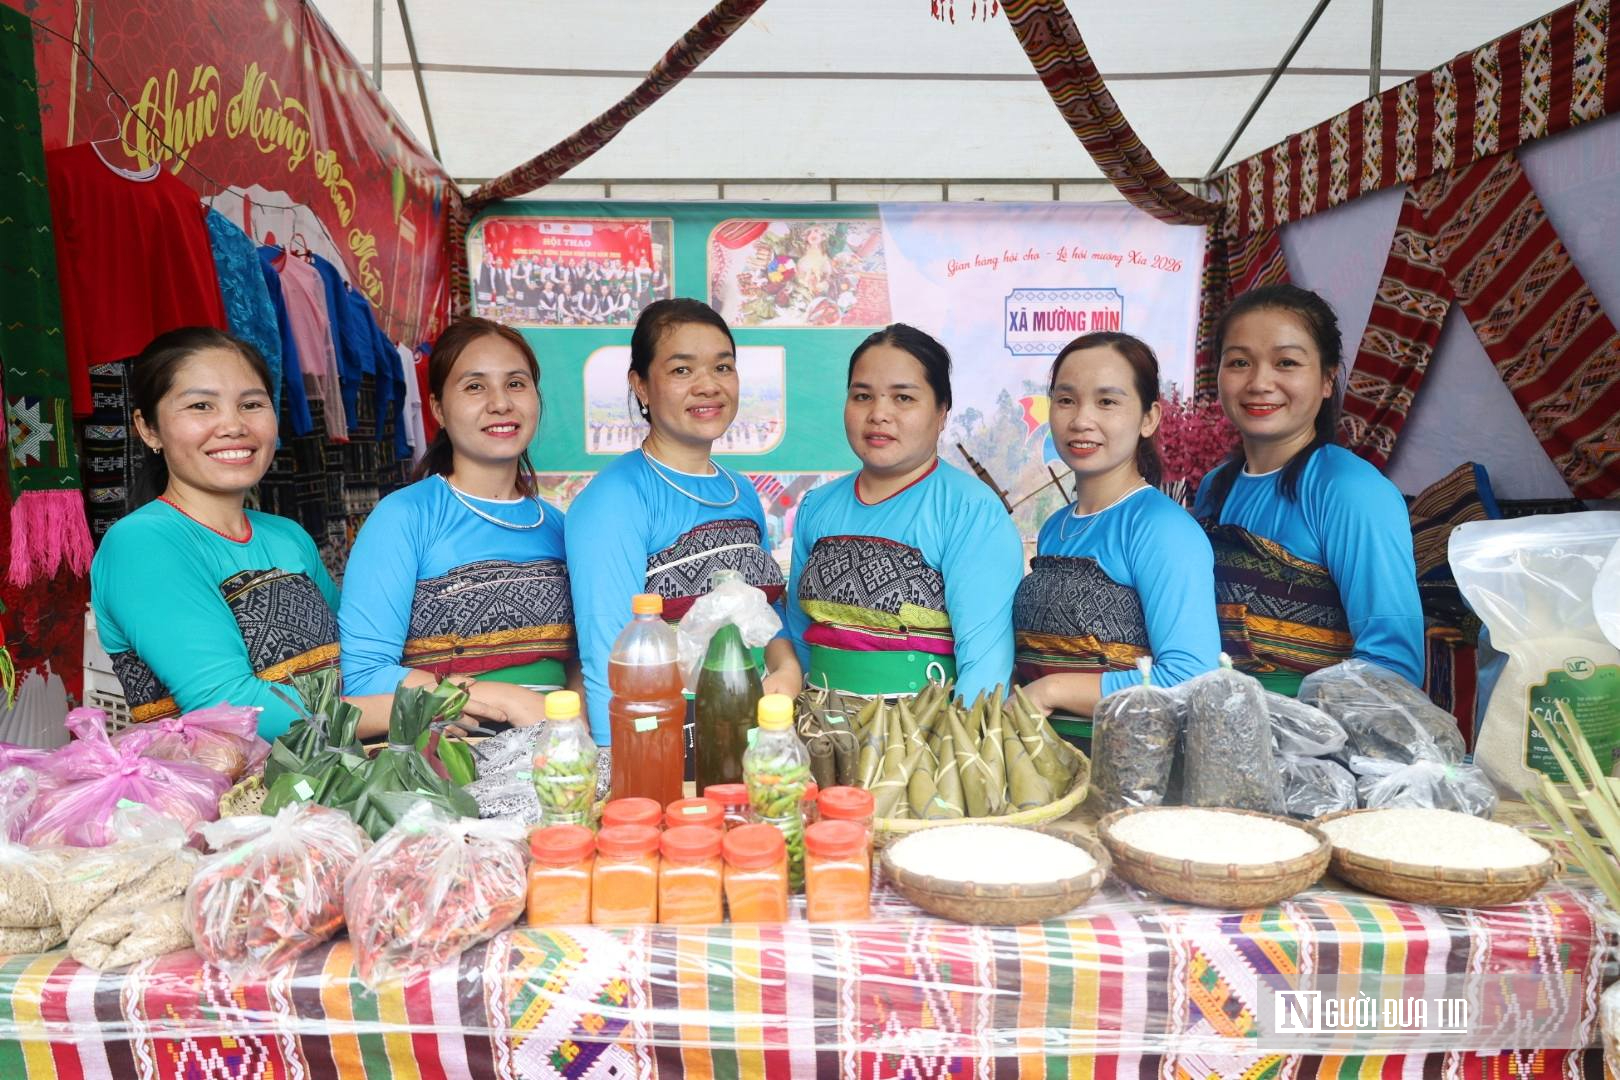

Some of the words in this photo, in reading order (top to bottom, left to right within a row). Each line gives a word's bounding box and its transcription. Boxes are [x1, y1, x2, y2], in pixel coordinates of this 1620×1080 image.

[947, 258, 971, 277] Gian
[1128, 249, 1148, 266] Xia
[1151, 254, 1184, 273] 2026
[1009, 306, 1028, 332] XÃ
[1033, 305, 1087, 332] MƯỜNG
